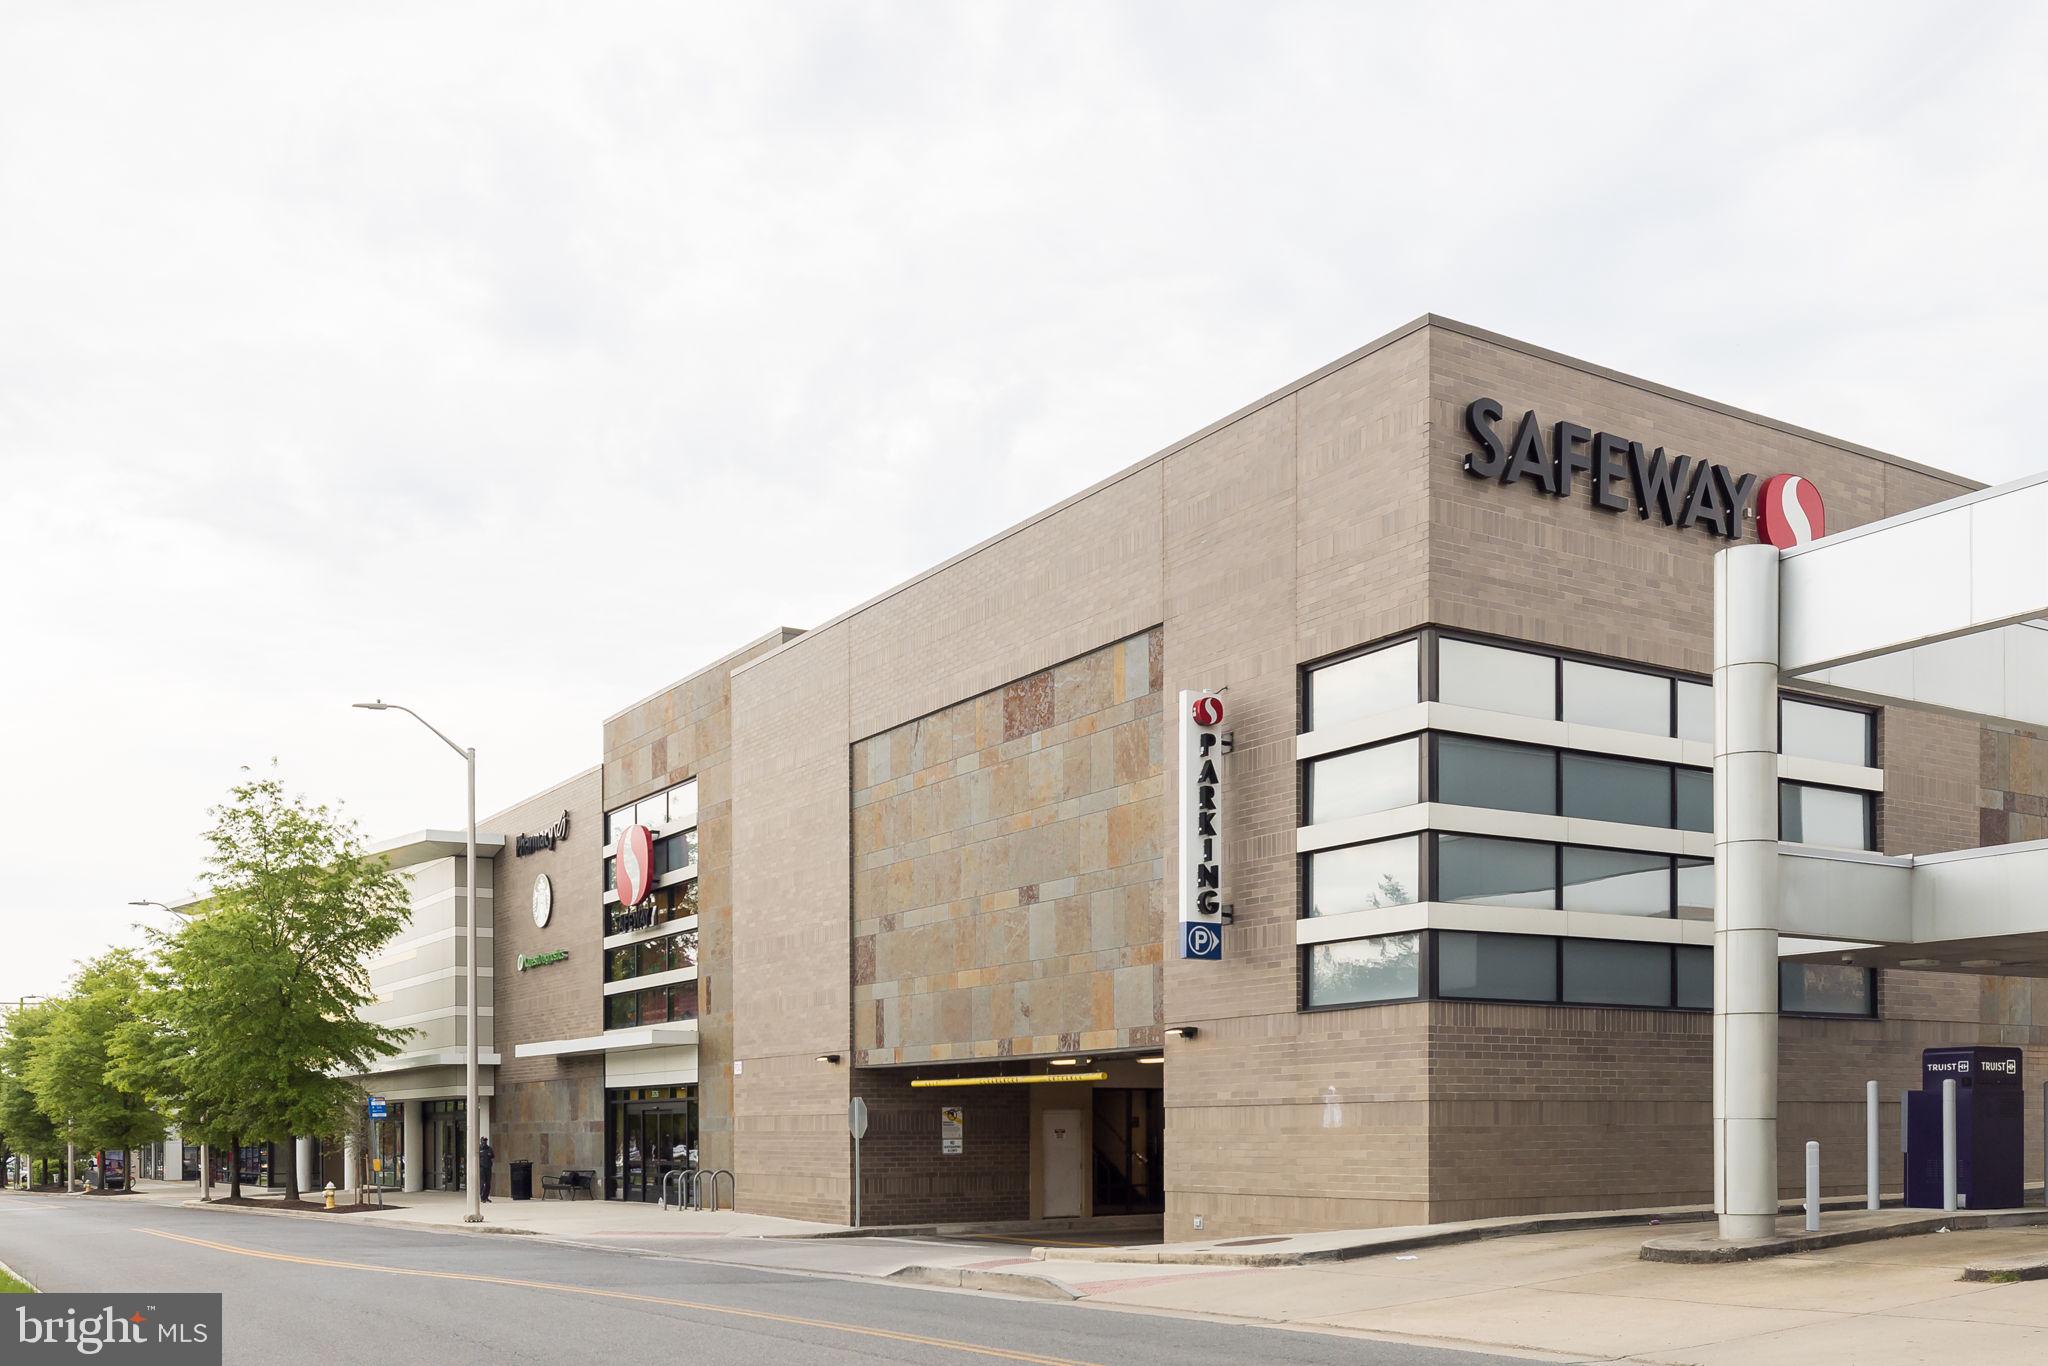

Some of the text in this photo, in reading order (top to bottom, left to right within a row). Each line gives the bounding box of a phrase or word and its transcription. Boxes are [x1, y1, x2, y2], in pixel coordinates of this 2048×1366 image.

[1464, 397, 1757, 540] SAFEWAY
[1197, 733, 1220, 915] PARKING
[516, 829, 556, 858] Pharmacy
[1928, 1063, 1957, 1071] TRUIST
[1981, 1061, 2006, 1071] TRUIST
